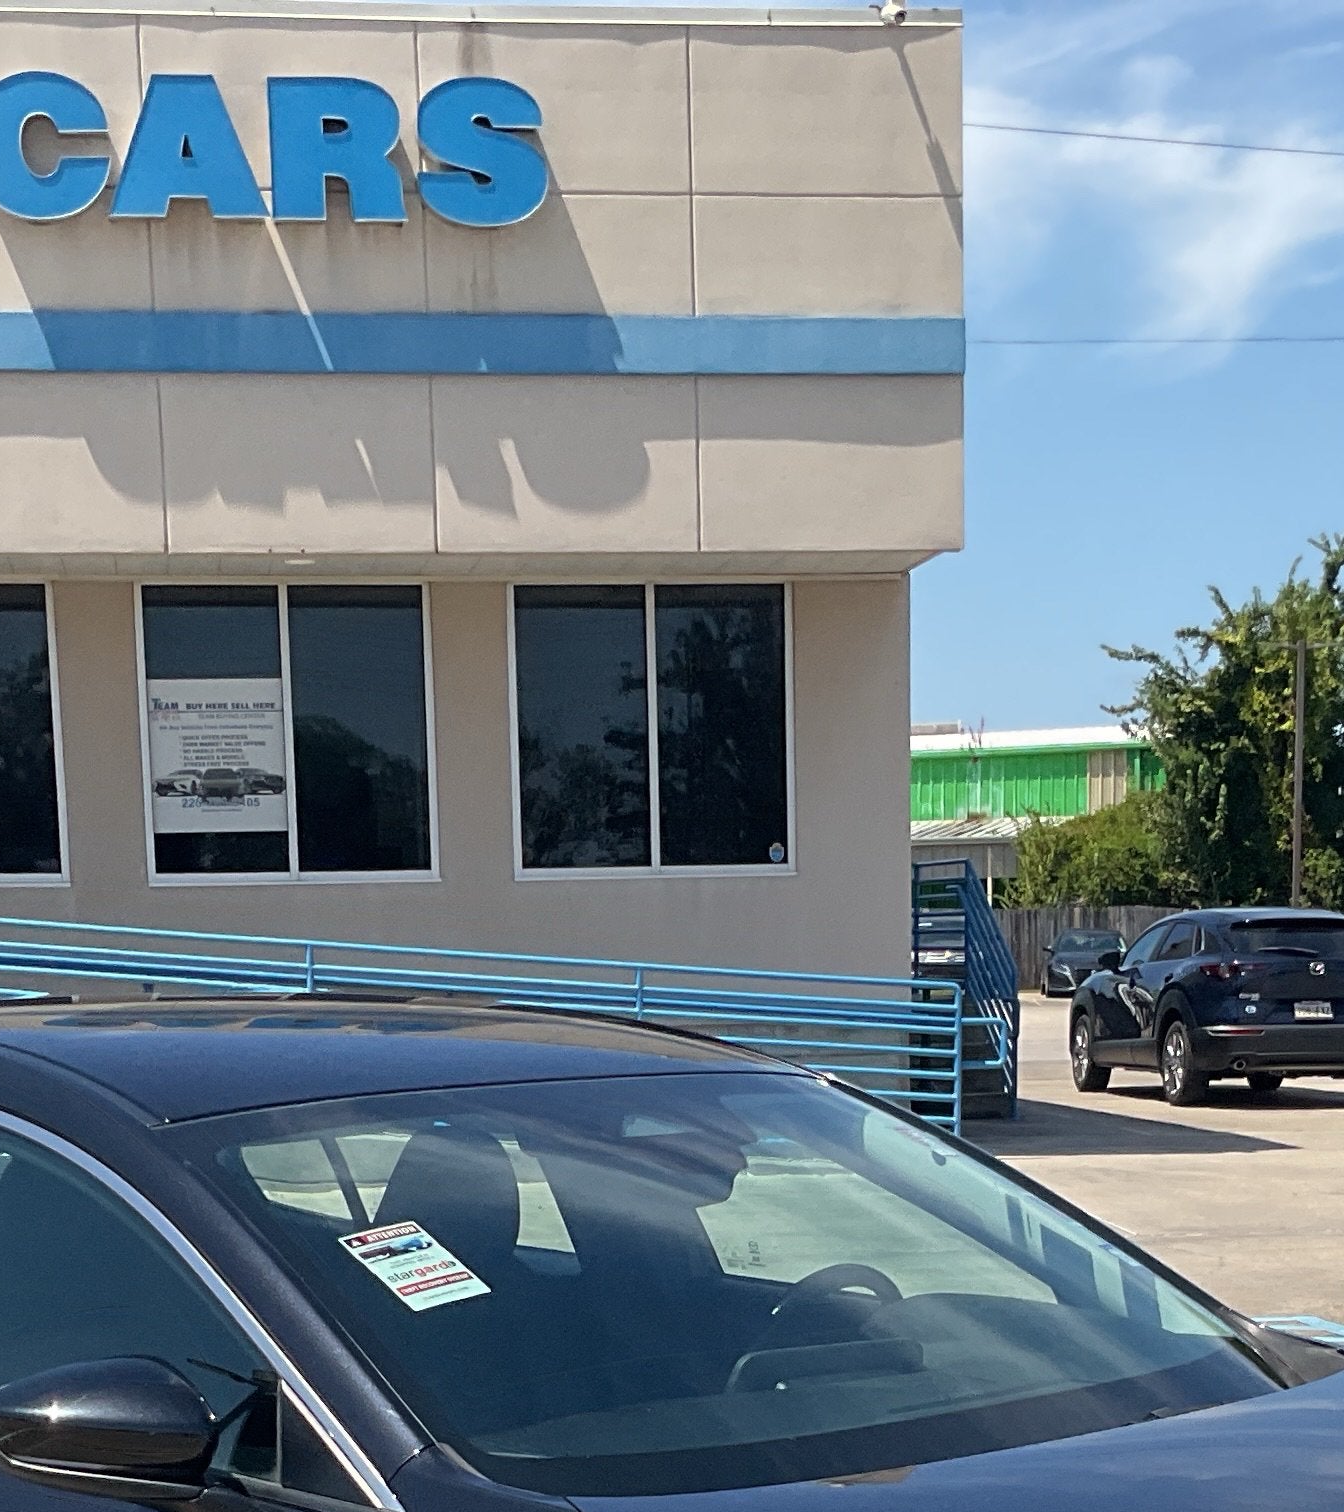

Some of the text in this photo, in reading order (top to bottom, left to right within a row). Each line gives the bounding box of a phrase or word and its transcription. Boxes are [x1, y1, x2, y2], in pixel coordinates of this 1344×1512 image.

[186, 702, 203, 710] BUY
[205, 702, 229, 710] HERE
[231, 702, 250, 710] SELL
[367, 1225, 418, 1243] ATTENTION
